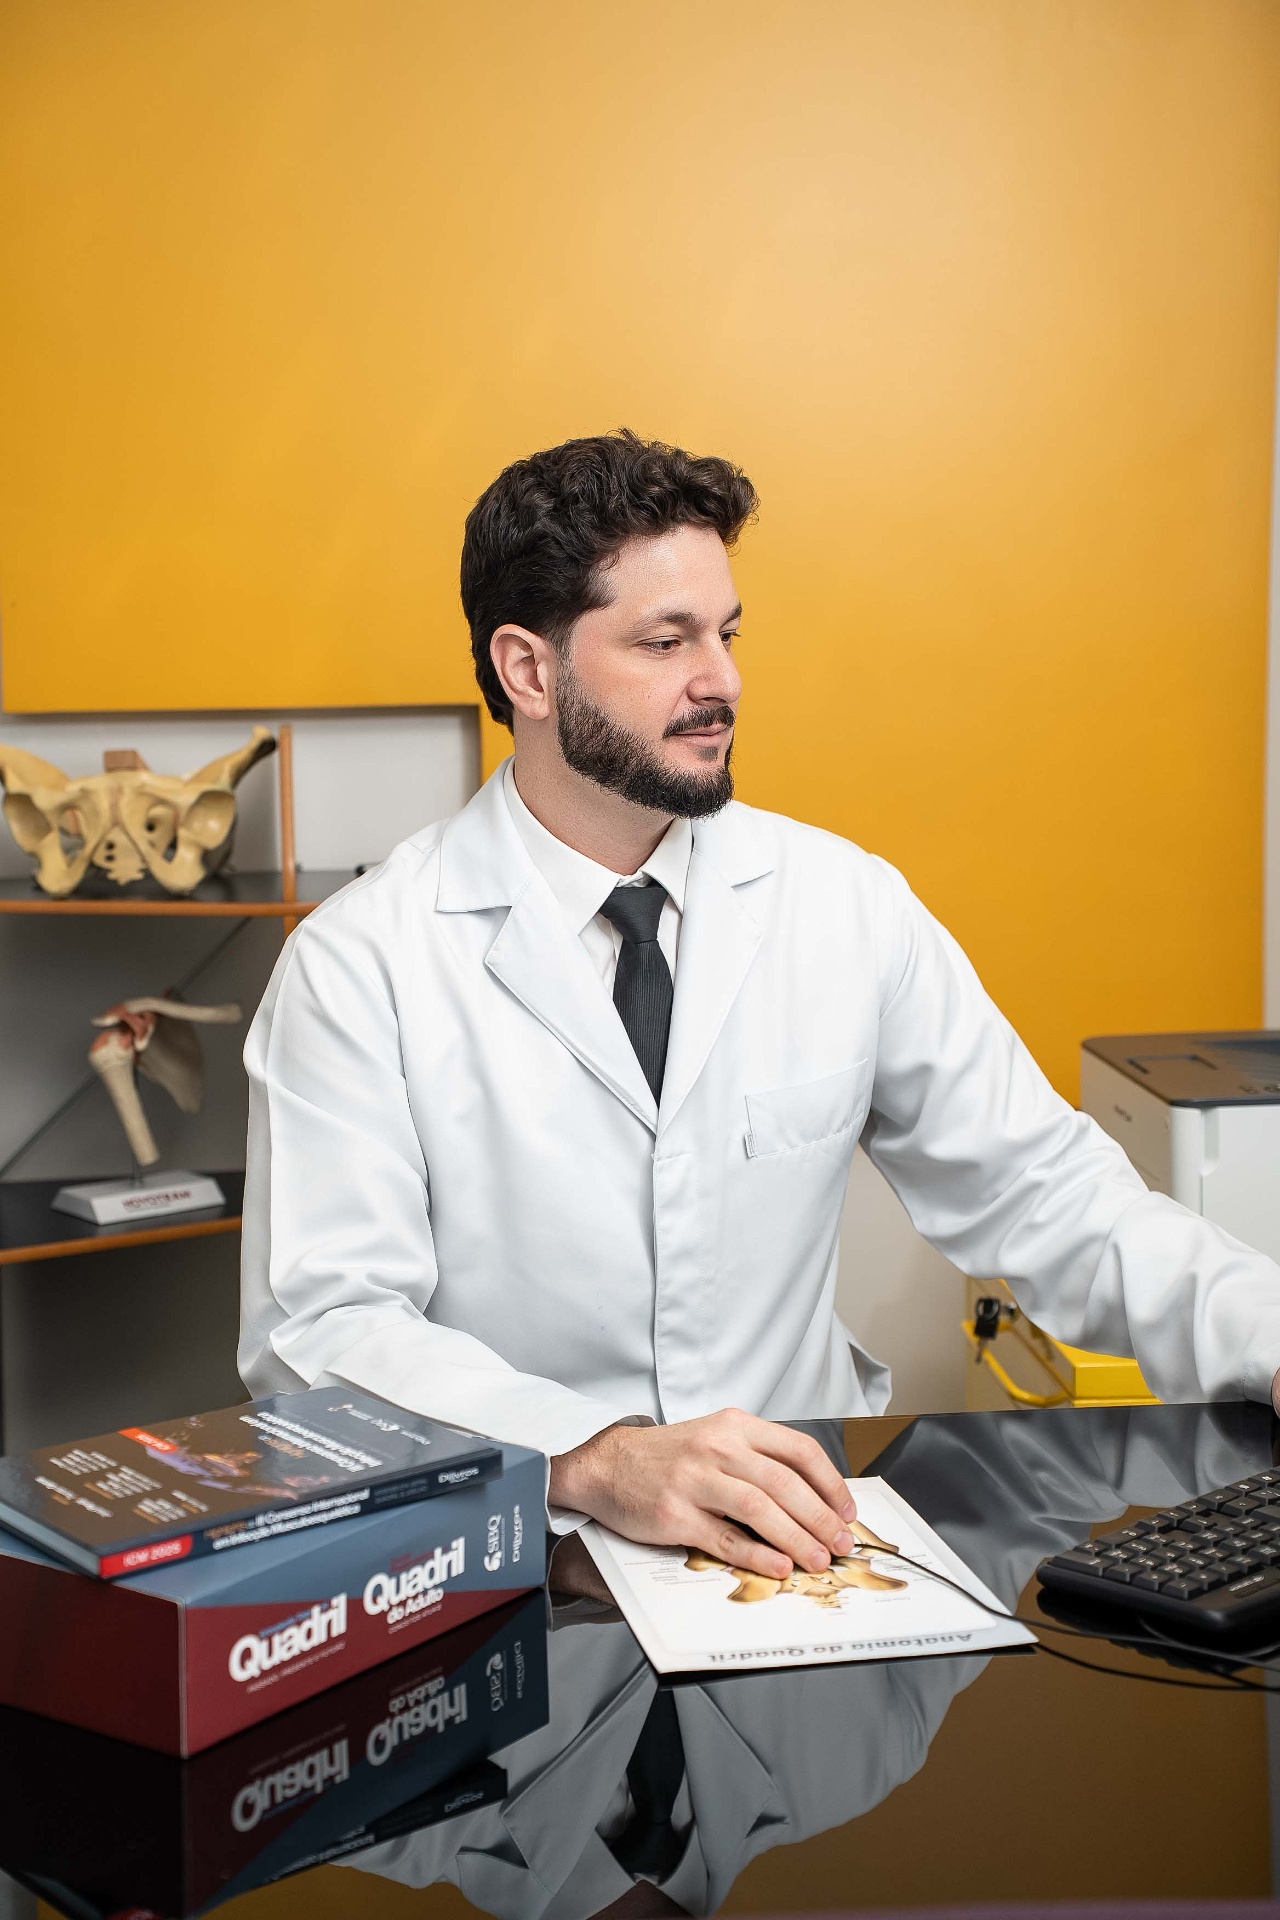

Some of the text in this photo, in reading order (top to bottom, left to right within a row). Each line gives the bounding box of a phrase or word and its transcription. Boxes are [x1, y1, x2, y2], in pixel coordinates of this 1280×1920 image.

[487, 1513, 502, 1554] SBQ
[363, 1536, 466, 1616] Quadril
[386, 1587, 445, 1625] do Adulto
[228, 1591, 348, 1683] Quadril
[708, 1632, 973, 1664] Anatomia do Quadril
